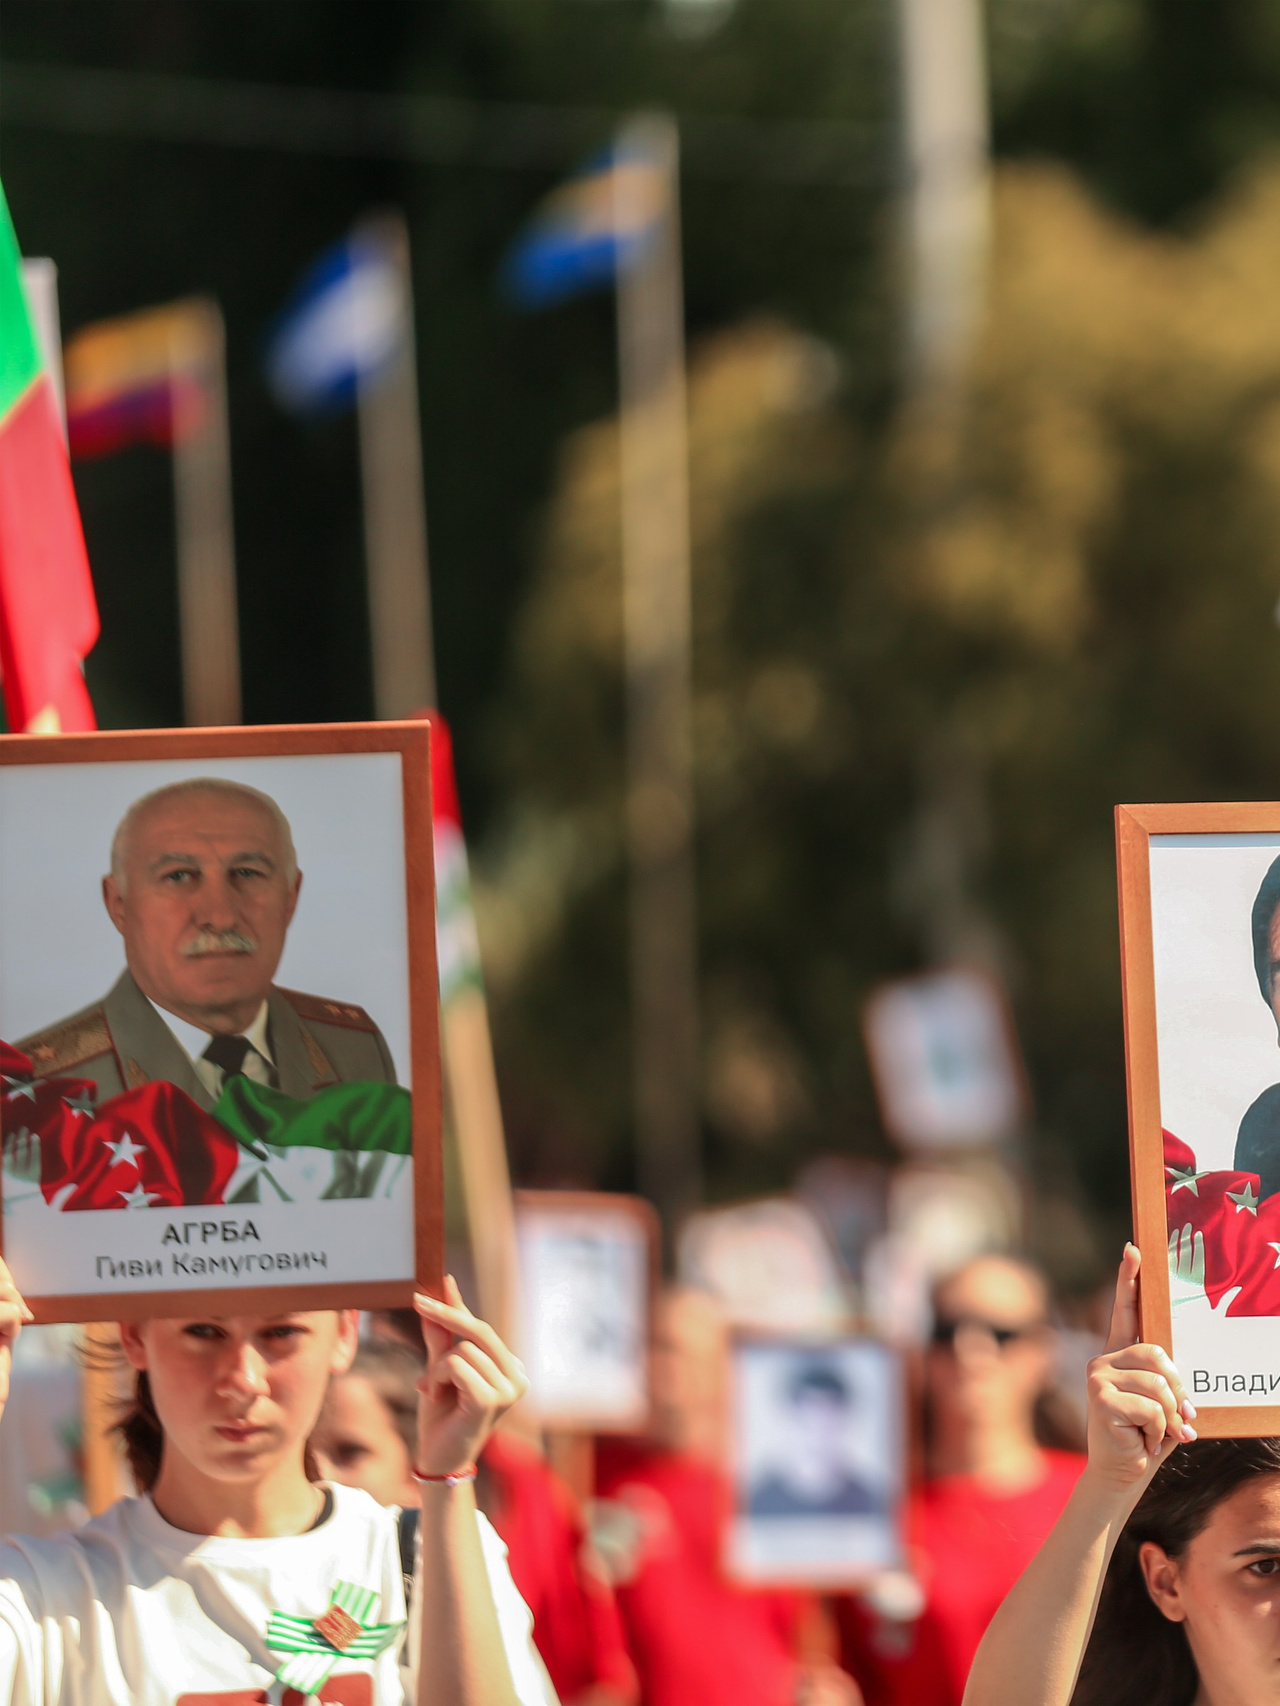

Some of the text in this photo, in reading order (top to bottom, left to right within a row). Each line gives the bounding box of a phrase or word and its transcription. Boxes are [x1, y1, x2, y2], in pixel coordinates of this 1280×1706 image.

[162, 1219, 260, 1246] АГРБА
[95, 1250, 328, 1279] Гиви Камугович
